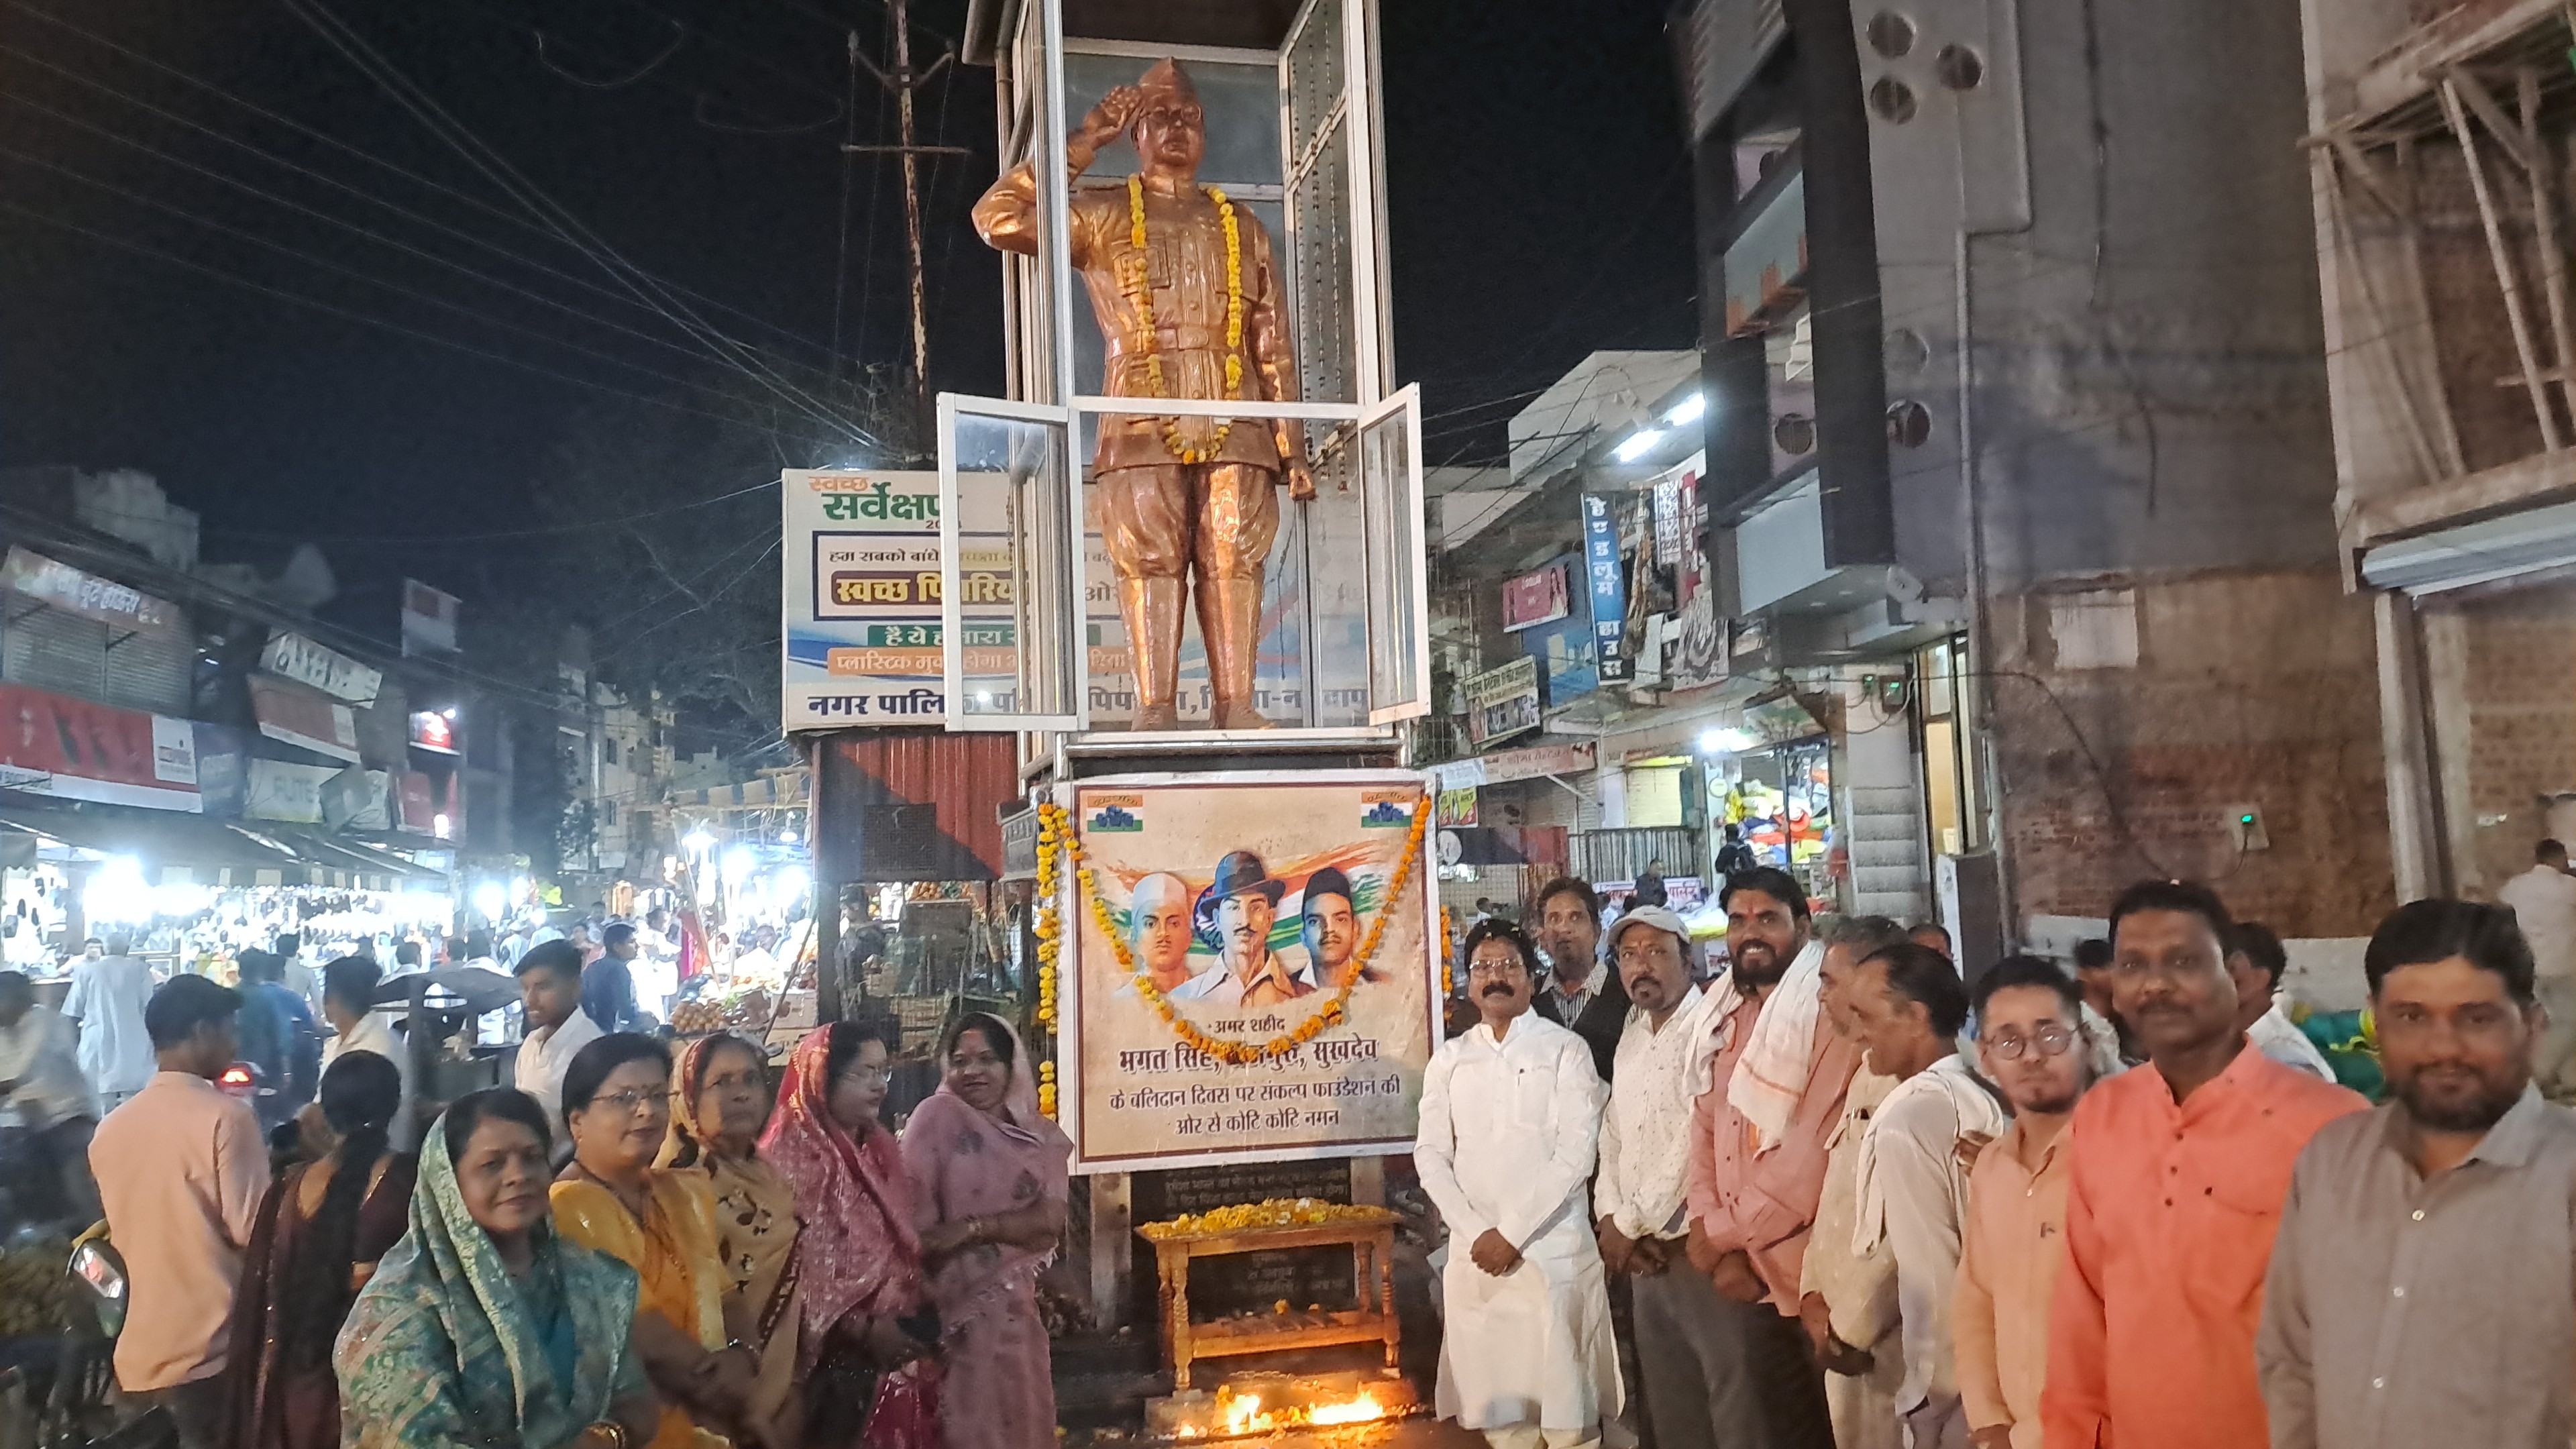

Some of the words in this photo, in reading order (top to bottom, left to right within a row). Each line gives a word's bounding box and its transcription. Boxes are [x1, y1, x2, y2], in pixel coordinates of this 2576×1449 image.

[808, 476, 869, 491] स्वच्छ
[830, 551, 855, 562] हम
[859, 548, 906, 562] सबको
[837, 578, 911, 602] स्वच्छ
[907, 627, 926, 645] ये
[807, 696, 871, 716] नगर
[1214, 1019, 1246, 1034] अमर
[1250, 1014, 1286, 1032] शहीद
[1120, 1050, 1169, 1072] भगत
[1174, 1042, 1220, 1073] सिह,
[1313, 1033, 1378, 1068] सुखदेव
[1110, 1089, 1125, 1110] के
[1191, 1084, 1230, 1106] दिवस
[1234, 1085, 1255, 1102] पर
[1260, 1080, 1307, 1100] संकल्प
[1312, 1077, 1376, 1097] फाउंडेशन
[1381, 1074, 1401, 1095] की
[1175, 1113, 1203, 1134] ओर
[1208, 1111, 1222, 1133] से
[1226, 1108, 1260, 1132] कोटि
[1265, 1107, 1300, 1129] कोटि
[1304, 1110, 1340, 1126] नमन
